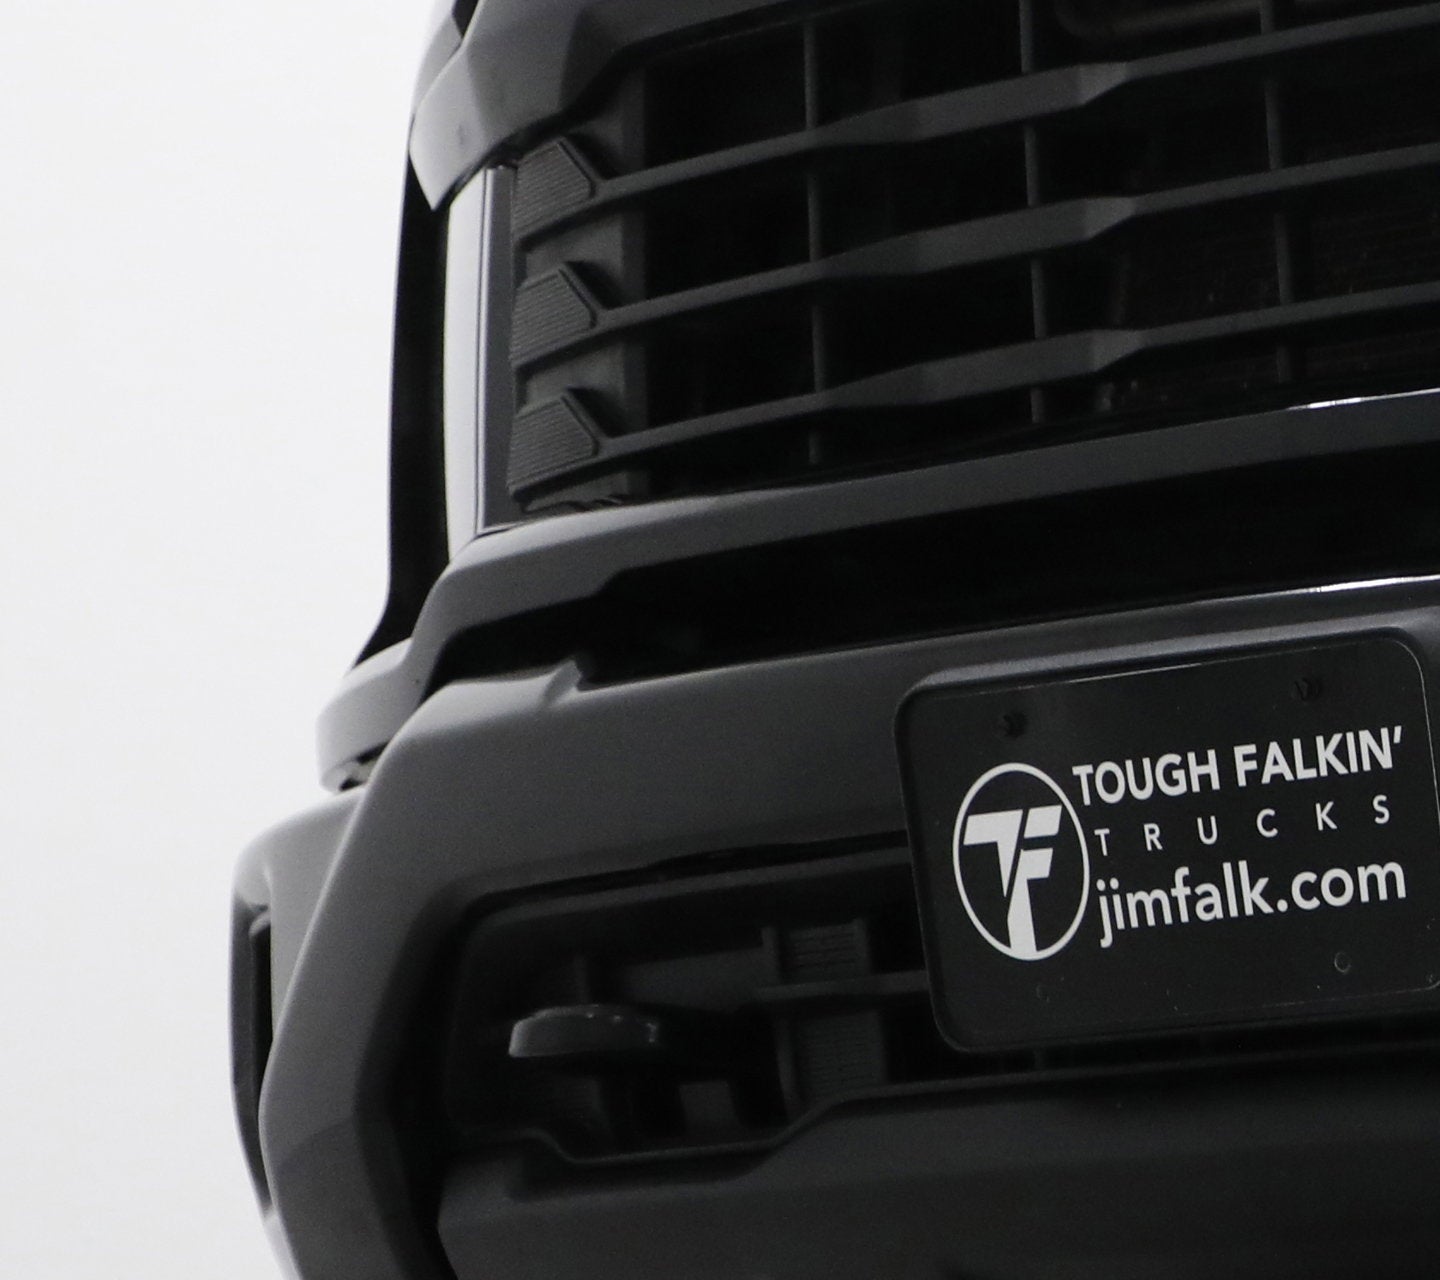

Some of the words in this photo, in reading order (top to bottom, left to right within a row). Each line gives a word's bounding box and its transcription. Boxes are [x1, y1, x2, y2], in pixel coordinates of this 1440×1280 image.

[1072, 749, 1221, 806] TOUGH
[1093, 794, 1390, 857] TRUCKS
[1096, 859, 1407, 949] jimfalk.com
